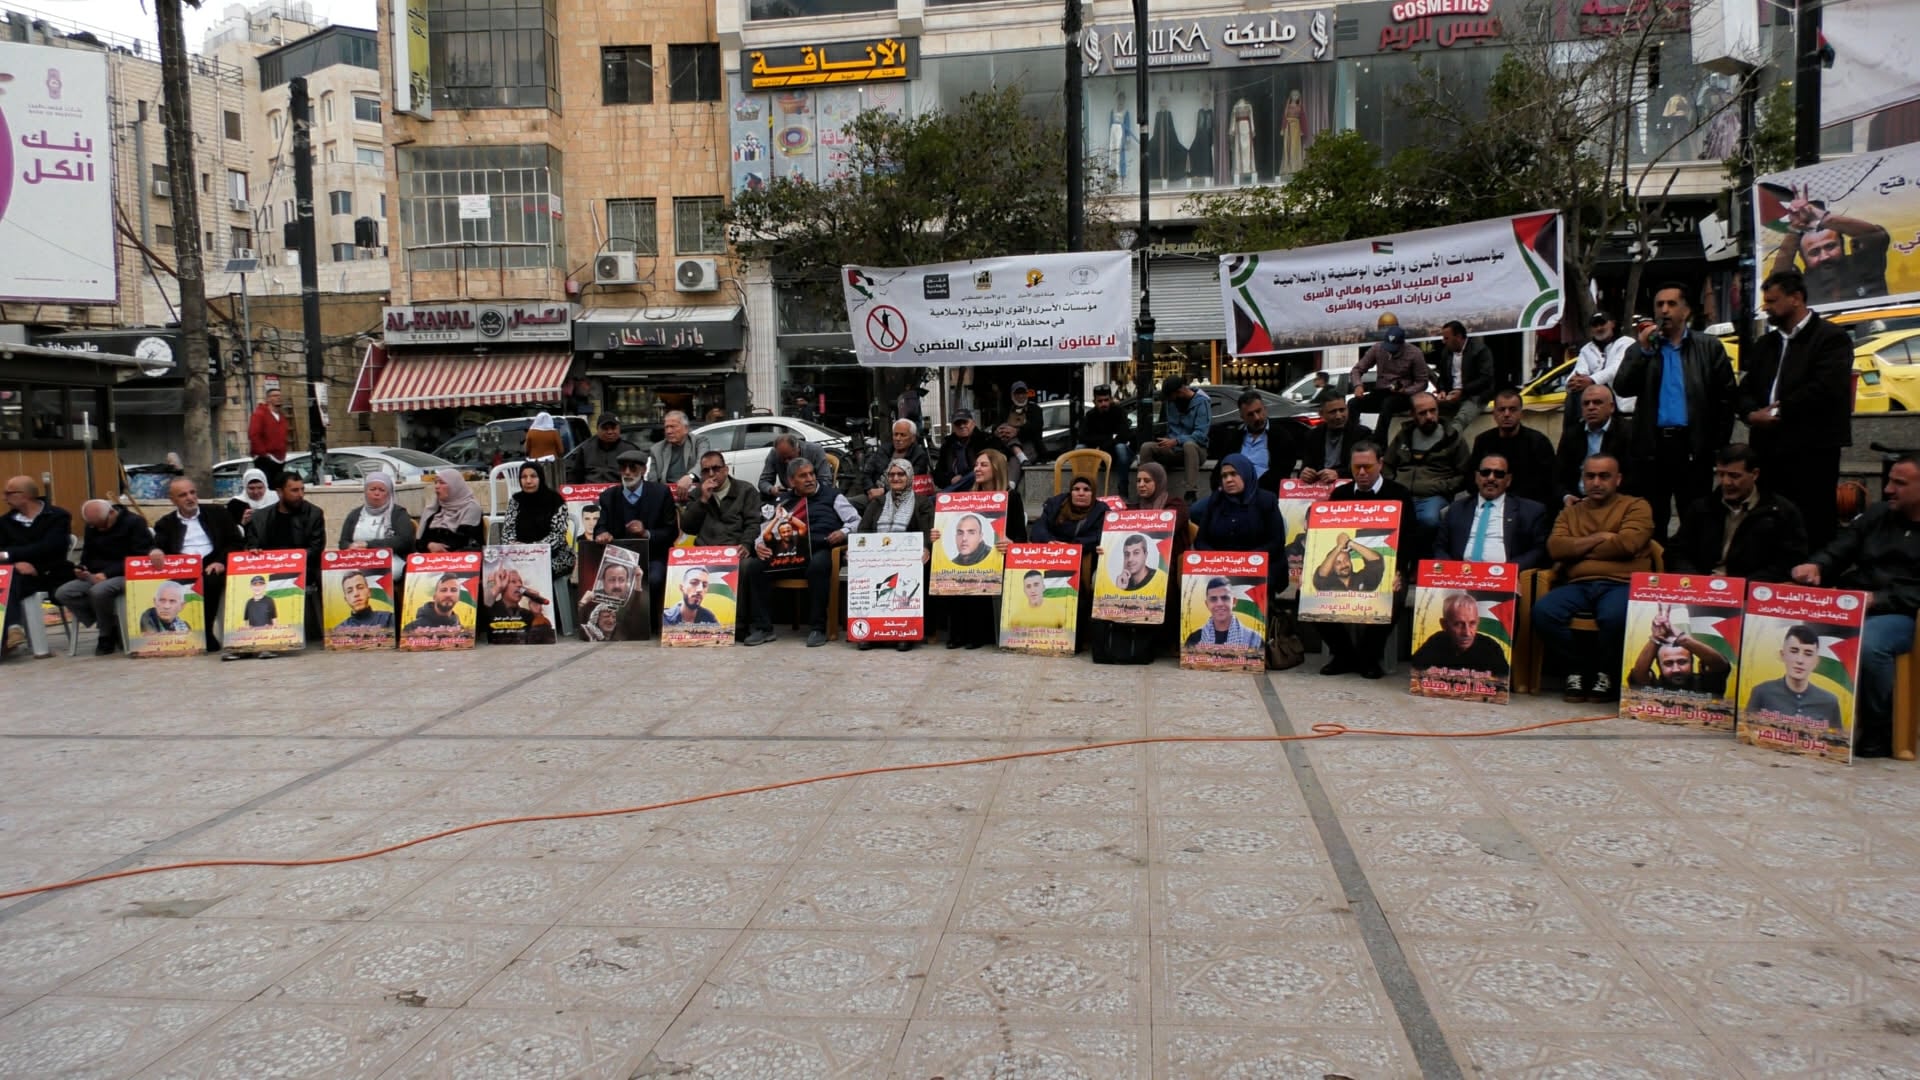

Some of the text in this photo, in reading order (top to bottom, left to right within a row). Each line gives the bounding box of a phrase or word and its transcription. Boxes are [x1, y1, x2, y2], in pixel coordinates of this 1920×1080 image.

[1392, 0, 1489, 21] COSMETICS
[1113, 22, 1211, 57] MLIKA
[1223, 19, 1297, 48] مليكة
[750, 38, 906, 75] الأناقة
[21, 130, 93, 158] بنك
[23, 158, 94, 185] الكل
[1409, 252, 1445, 273] الأسرى
[1446, 249, 1505, 266] مؤسسات
[1327, 264, 1371, 280] الوطنية
[1373, 260, 1406, 277] والقوى
[1403, 274, 1440, 289] الصليب
[1440, 273, 1466, 288] لمنع
[1465, 272, 1475, 283] لا
[1302, 285, 1334, 301] الأسرى
[1372, 278, 1403, 294] الأحمر
[1062, 303, 1097, 313] مؤسسات
[1325, 289, 1452, 314] من زيارات السجون والأسرى
[973, 306, 1004, 315] الوطنية
[1005, 305, 1032, 316] والقوى
[386, 309, 475, 331] AL-KAMAL
[508, 308, 568, 330] الكمال
[961, 317, 1065, 330] في محافظة رام الله والبيرة
[607, 327, 705, 350] بازار السلطان
[913, 334, 1116, 356] لا لقانون إعدام الأسرى العنصري
[952, 494, 991, 504] الهيئة العليا
[1120, 513, 1159, 522] الهيئة العليا
[1329, 504, 1380, 515] الهيئة العليا
[245, 554, 265, 563] العليا
[1023, 547, 1064, 556] الهيئة العليا
[1204, 555, 1246, 565] الهيئة العليا
[1775, 591, 1833, 606] الهيئة العليا
[897, 629, 918, 637] قانون
[1685, 706, 1724, 722] مروان
